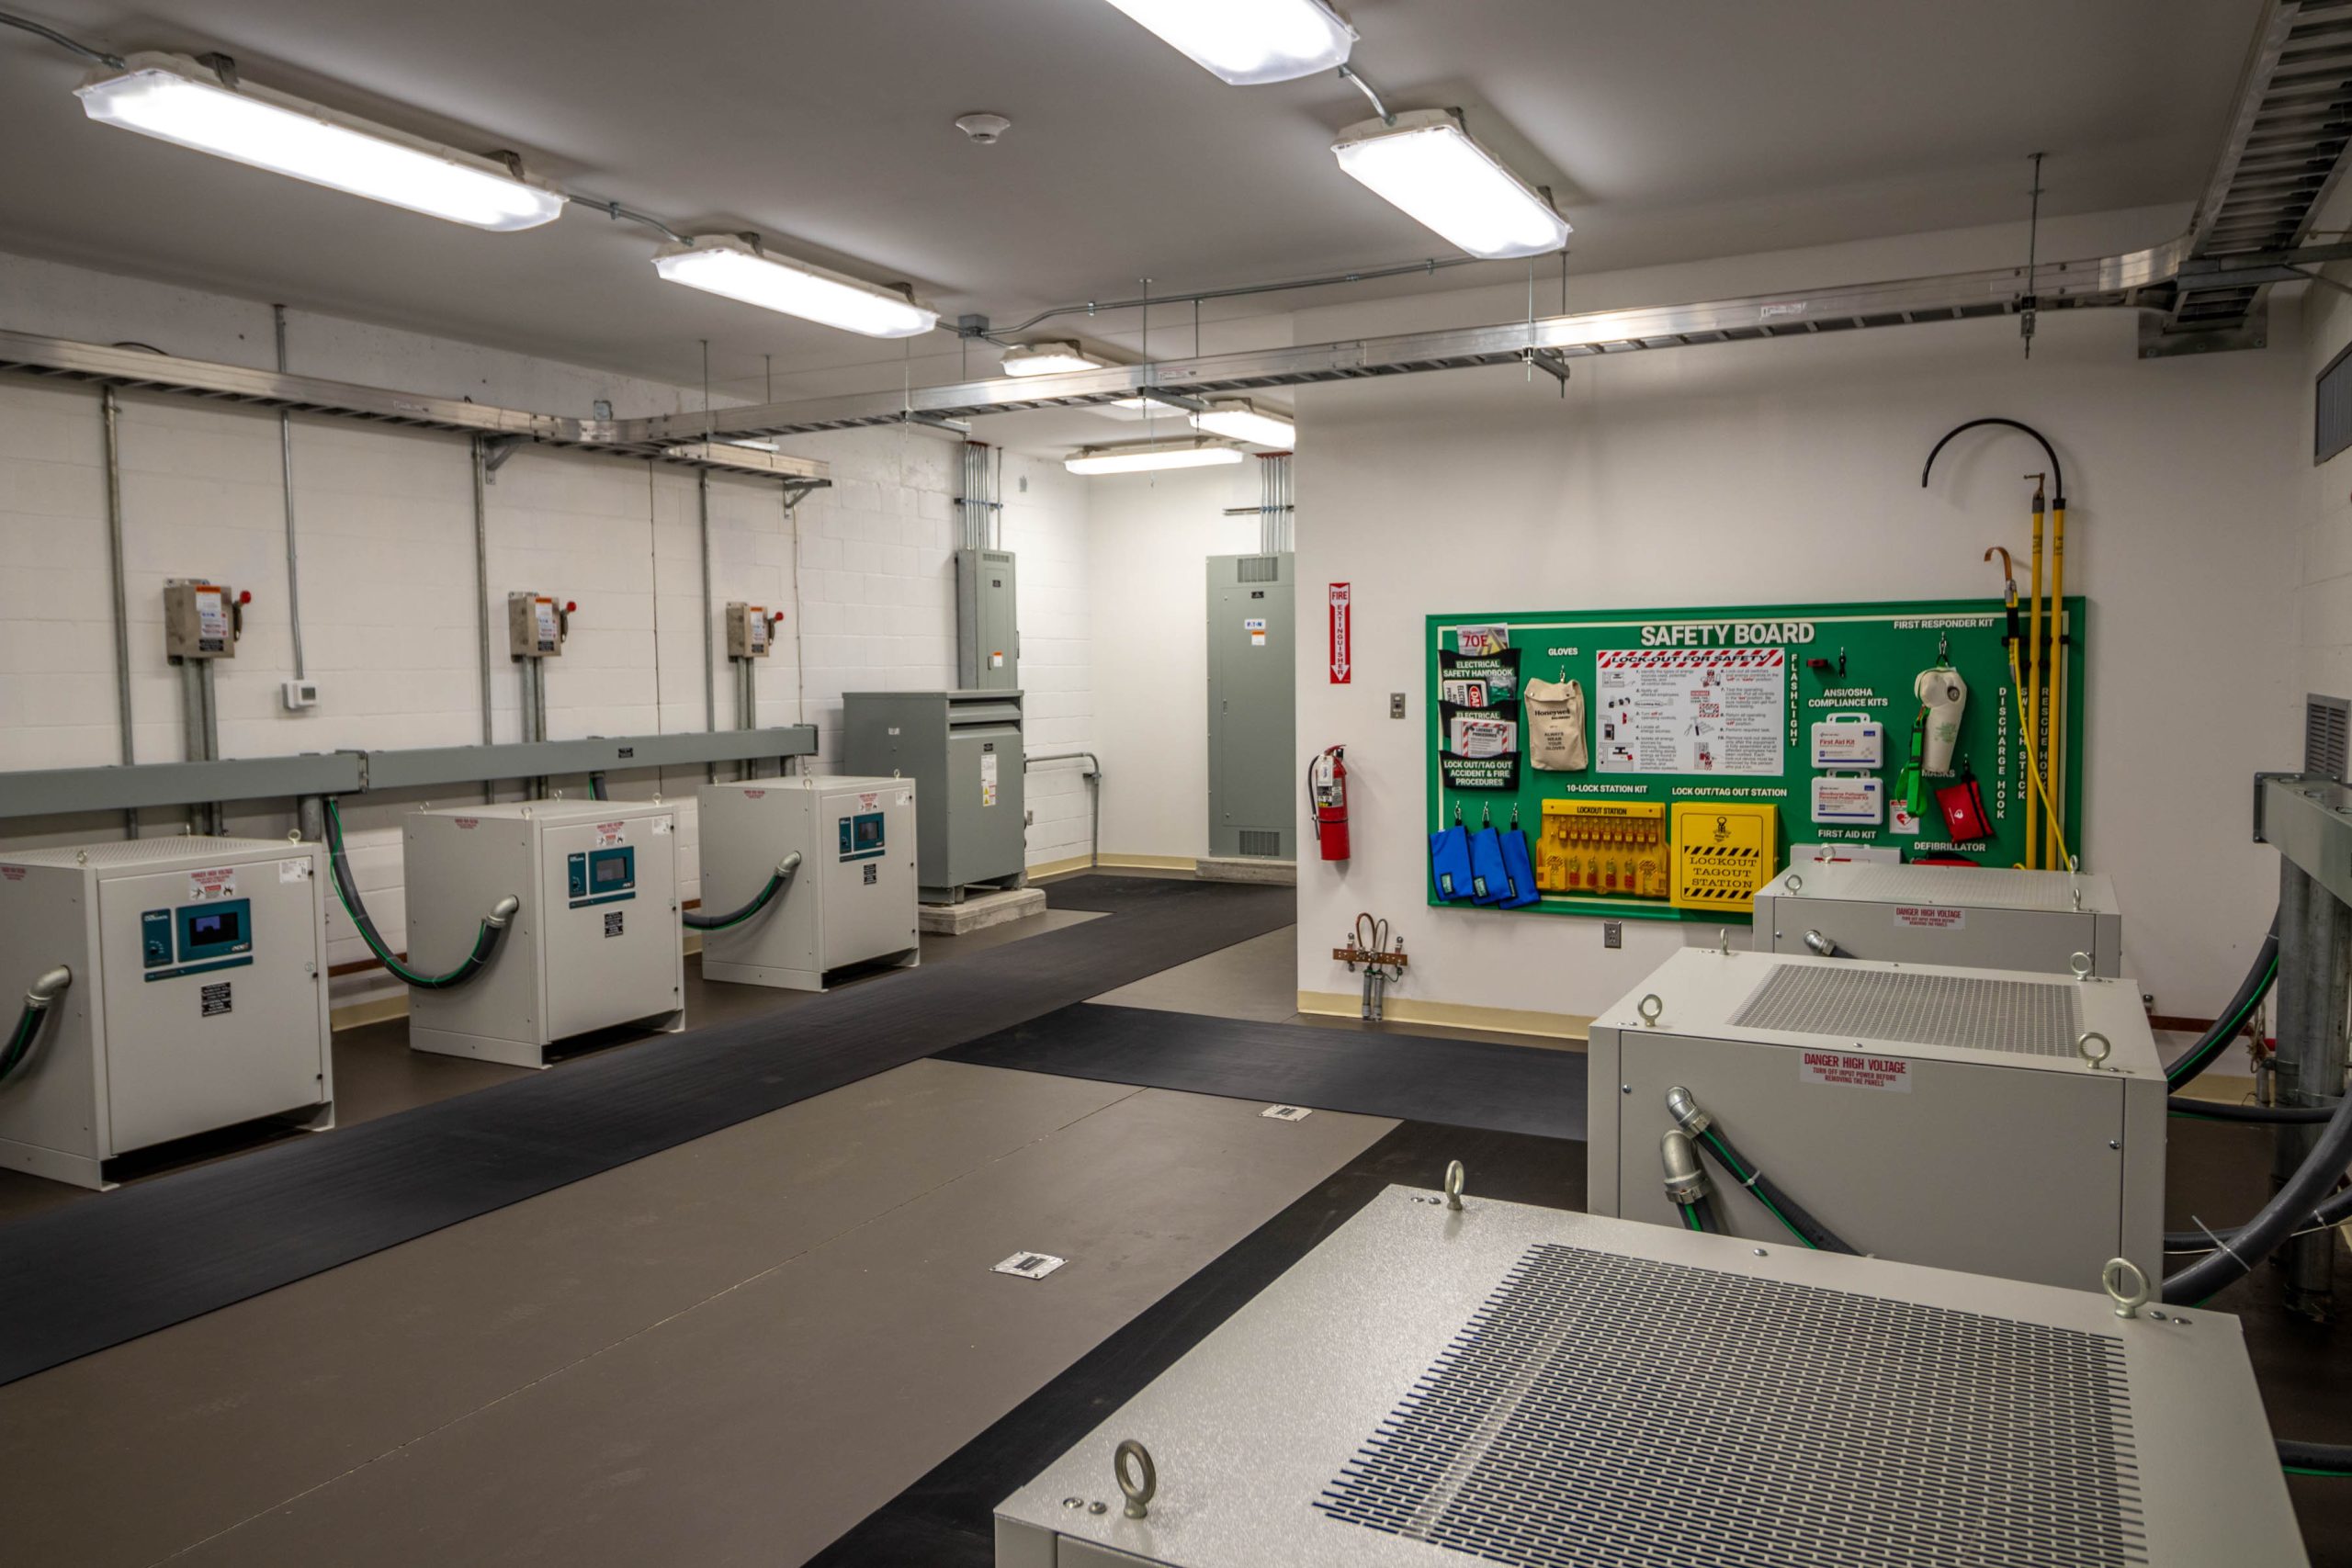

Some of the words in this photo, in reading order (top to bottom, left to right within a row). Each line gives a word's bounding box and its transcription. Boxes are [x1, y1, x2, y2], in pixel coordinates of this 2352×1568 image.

[1332, 591, 1348, 600] FIRE
[1894, 620, 1920, 629] FIRST
[1921, 619, 1977, 628] RESPONDER
[1978, 618, 1995, 627] KIT
[1641, 625, 1730, 647] SAFETY
[1735, 622, 1815, 644] BOARD
[1463, 634, 1488, 647] 70E
[1548, 648, 1577, 656] GLOVES
[1456, 660, 1500, 669] ELECTRICAL
[1471, 669, 1513, 677] HANDBOOK
[1824, 688, 1873, 697] ANSI/OSHA
[1790, 654, 1798, 747] FLASHLIGHT
[1808, 698, 1866, 707] COMPLIANCE
[1868, 698, 1888, 706] KITS
[2041, 687, 2049, 746] RESCUE
[1998, 687, 2007, 774] DISCHARGE
[2018, 751, 2027, 799] STICK
[1455, 778, 1503, 786] PROCEDURES
[1672, 787, 1693, 795] LOCK
[1694, 788, 1731, 796] OUT/TAG
[1732, 788, 1749, 796] OUT
[1751, 788, 1787, 796] STATION
[1996, 781, 2006, 818] HOOK
[1818, 829, 1844, 838] FIRST
[1845, 829, 1860, 838] AID
[1861, 830, 1876, 839] KIT
[1914, 841, 1985, 852] DEFIBRILLATOR
[1690, 857, 1757, 867] LOCKOUT
[1693, 868, 1751, 877] TAGOUT
[1691, 878, 1753, 888] STATION
[1896, 908, 1918, 916] DANGER
[1921, 908, 1935, 917] HIGH
[1937, 910, 1962, 919] VOLTAGE
[1804, 1054, 1838, 1067] DANGER
[1842, 1056, 1864, 1070] HIGH
[1868, 1059, 1906, 1074] VOLTAGE
[1825, 1075, 1852, 1083] REMOVING
[1865, 1078, 1884, 1087] PANELS
[1876, 1073, 1896, 1081] BEFORE
